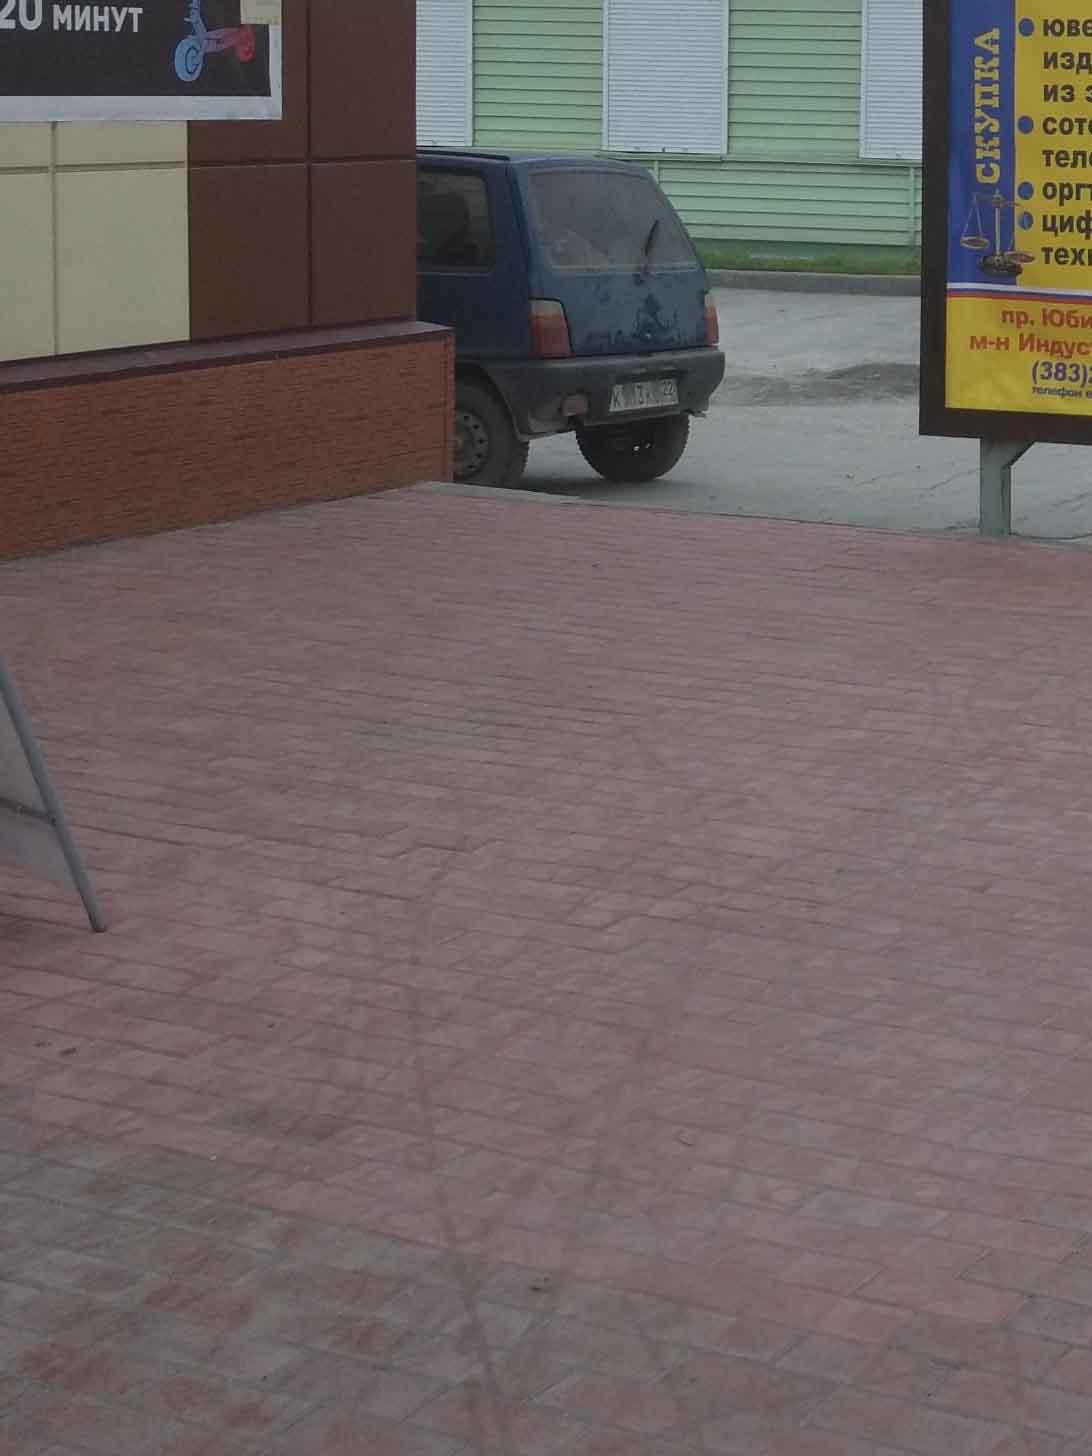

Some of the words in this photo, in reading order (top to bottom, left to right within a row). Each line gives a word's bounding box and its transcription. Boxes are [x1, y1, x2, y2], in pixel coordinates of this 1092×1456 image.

[53, 4, 144, 33] МИНУТ
[1043, 84, 1075, 103] из
[975, 28, 1000, 184] СКУПКА
[1001, 308, 1035, 329] пр.
[969, 335, 1010, 351] м-н
